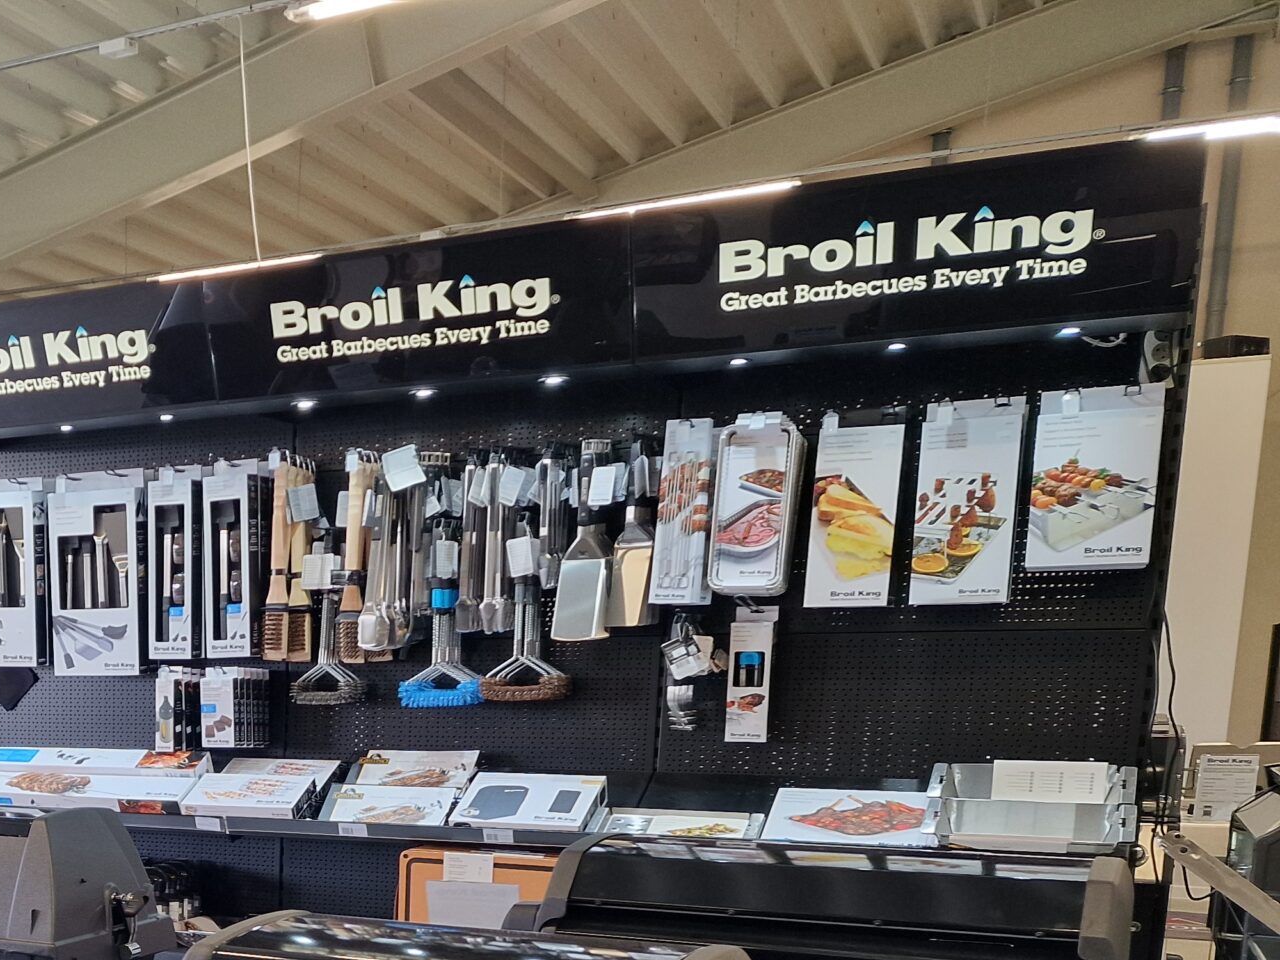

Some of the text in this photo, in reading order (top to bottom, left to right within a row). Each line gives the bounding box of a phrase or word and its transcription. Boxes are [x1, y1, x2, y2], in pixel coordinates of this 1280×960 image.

[719, 205, 1094, 284] Broil King
[269, 274, 551, 339] Broil King
[720, 257, 1087, 311] Great Barbecues Every Time
[43, 326, 149, 366] King
[277, 318, 550, 363] Great Barbecues Every Time
[61, 370, 105, 387] Every
[108, 365, 151, 382] Time
[1084, 546, 1143, 554] Broil King
